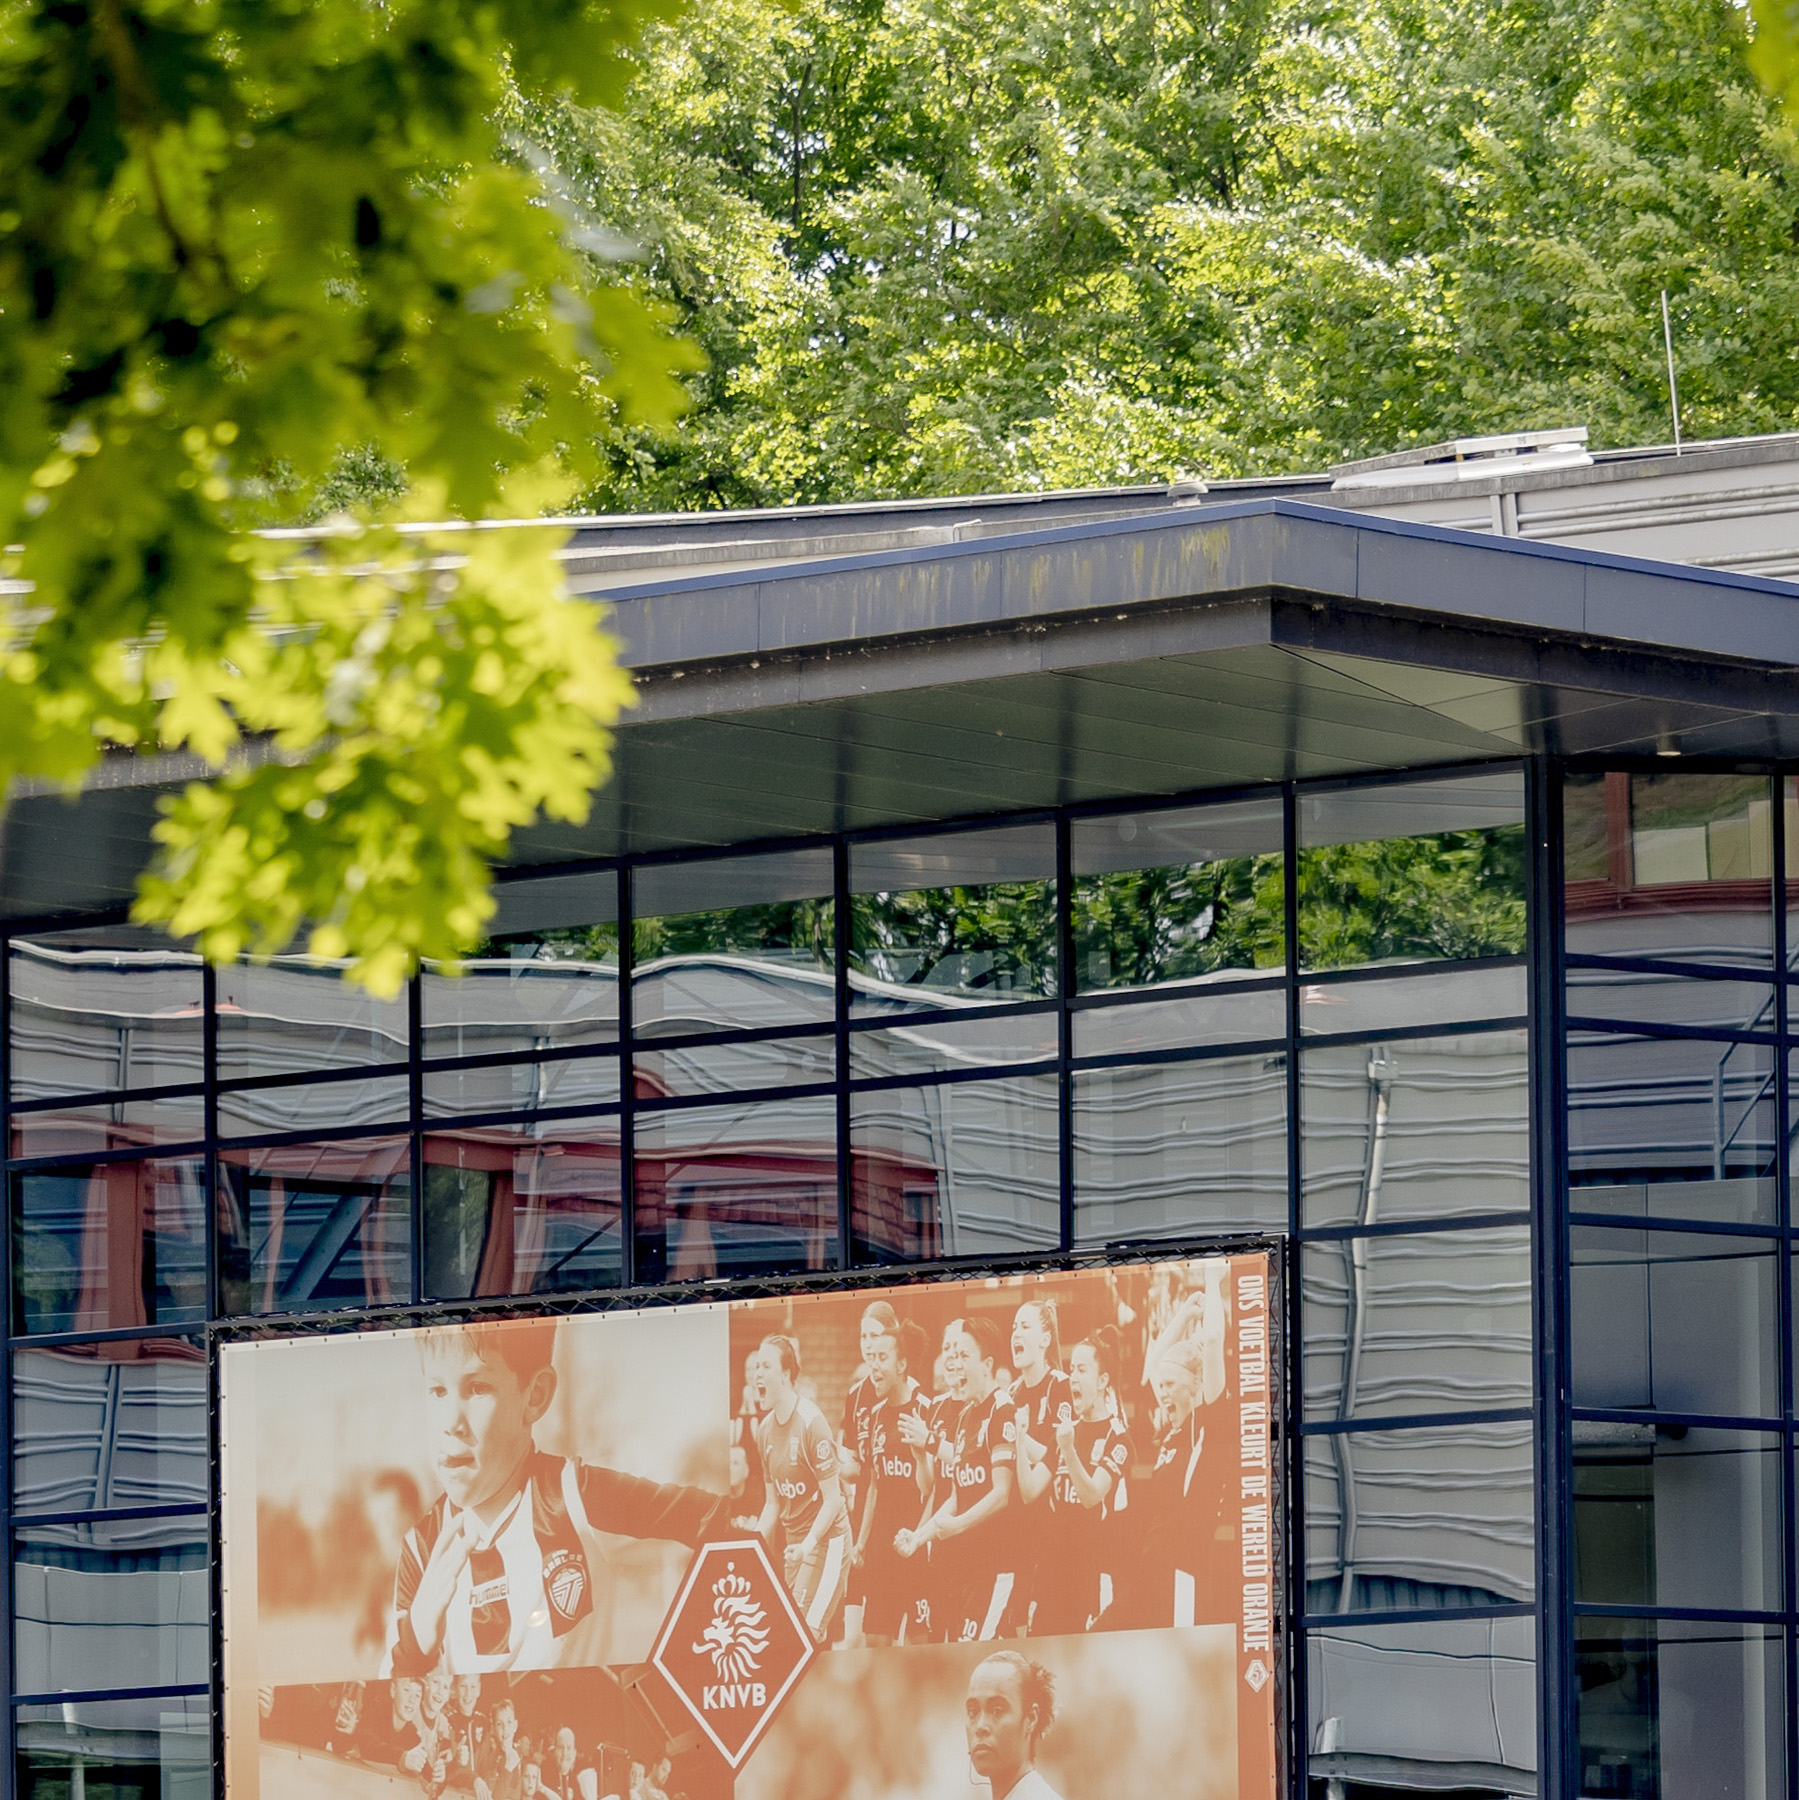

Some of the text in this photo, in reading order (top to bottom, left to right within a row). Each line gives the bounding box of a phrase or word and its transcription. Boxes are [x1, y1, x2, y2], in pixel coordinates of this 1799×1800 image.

[882, 1455, 912, 1478] lebo
[956, 1462, 986, 1488] lebo
[1238, 1275, 1269, 1653] ONS VOETBAL KLEURT DE WERELD ORANJE
[775, 1478, 806, 1499] lebo
[962, 1617, 978, 1639] 10
[703, 1682, 766, 1710] KNVB
